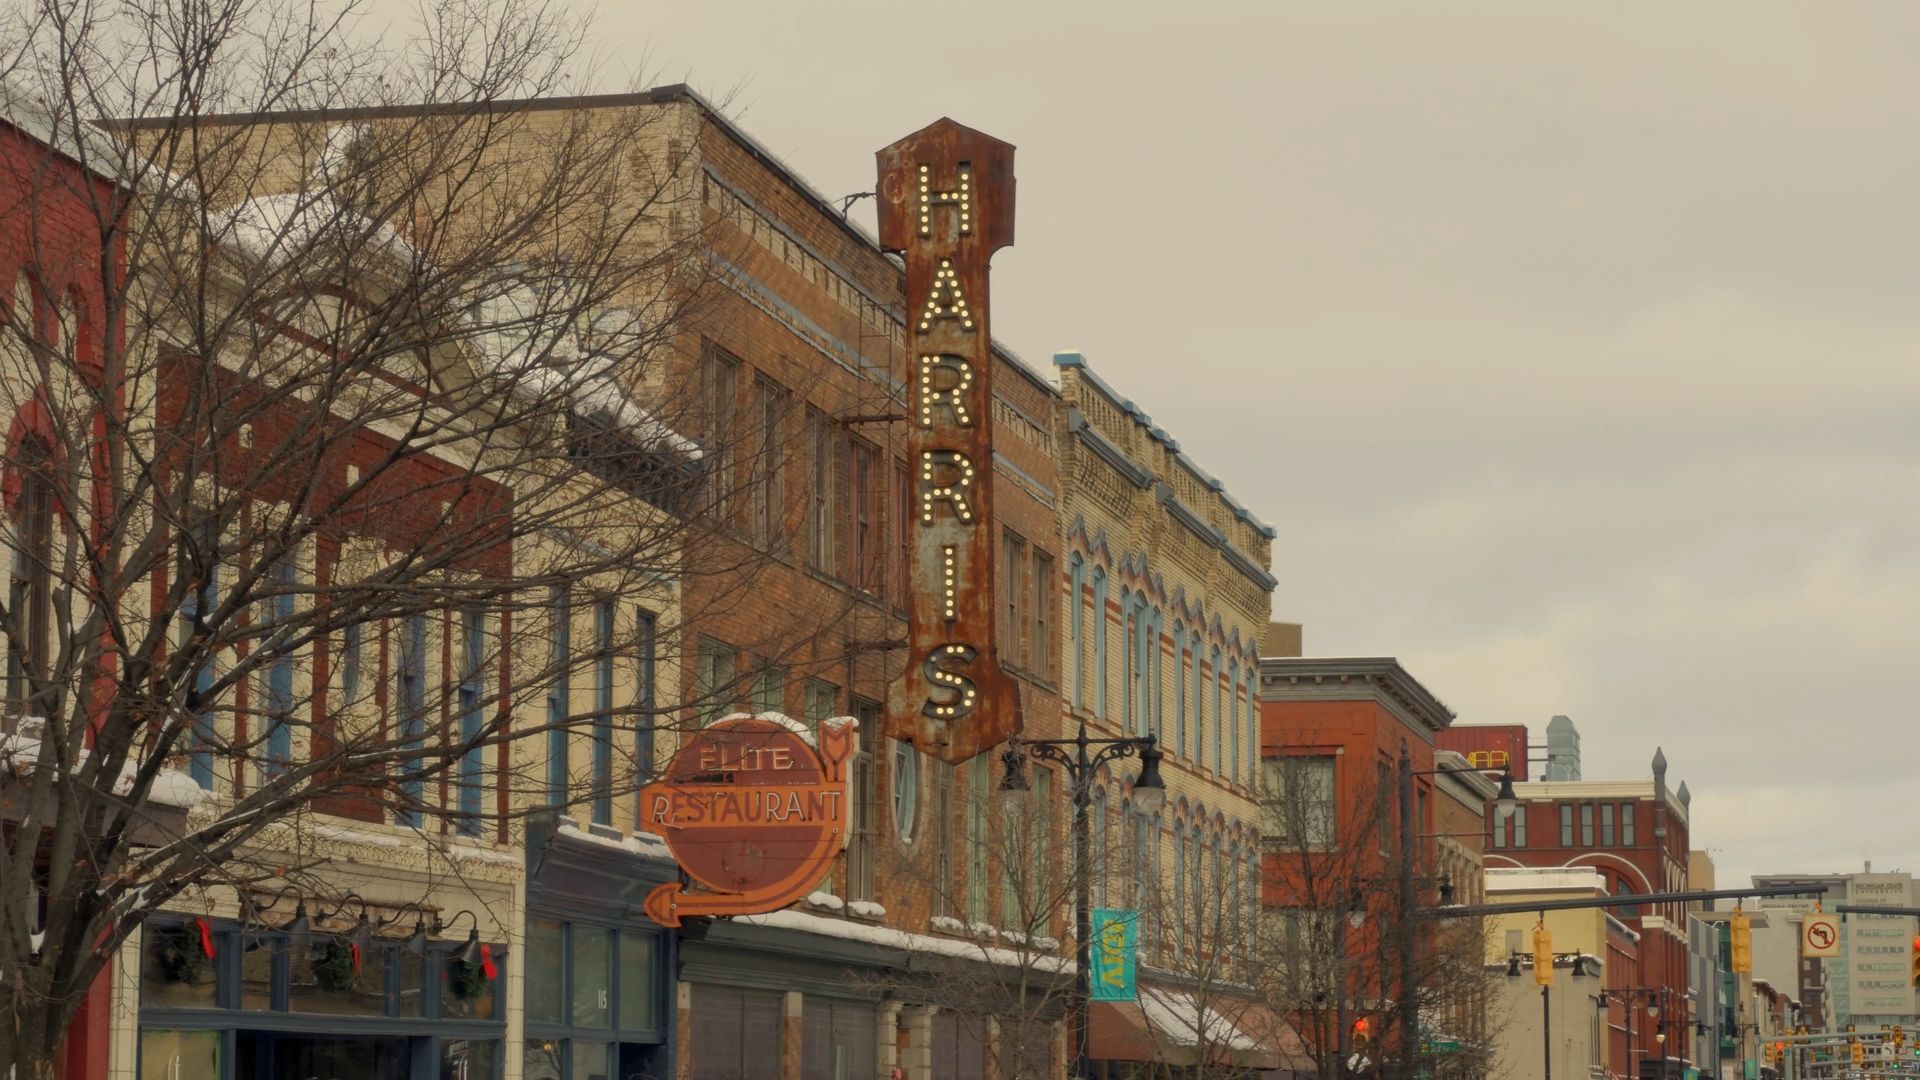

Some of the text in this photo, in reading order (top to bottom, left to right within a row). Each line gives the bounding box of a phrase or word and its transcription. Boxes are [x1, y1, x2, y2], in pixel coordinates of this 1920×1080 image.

[917, 160, 977, 721] HARRIS
[700, 744, 794, 771] ELITE
[651, 791, 841, 823] RESTAURANT
[598, 989, 607, 1009] 115
